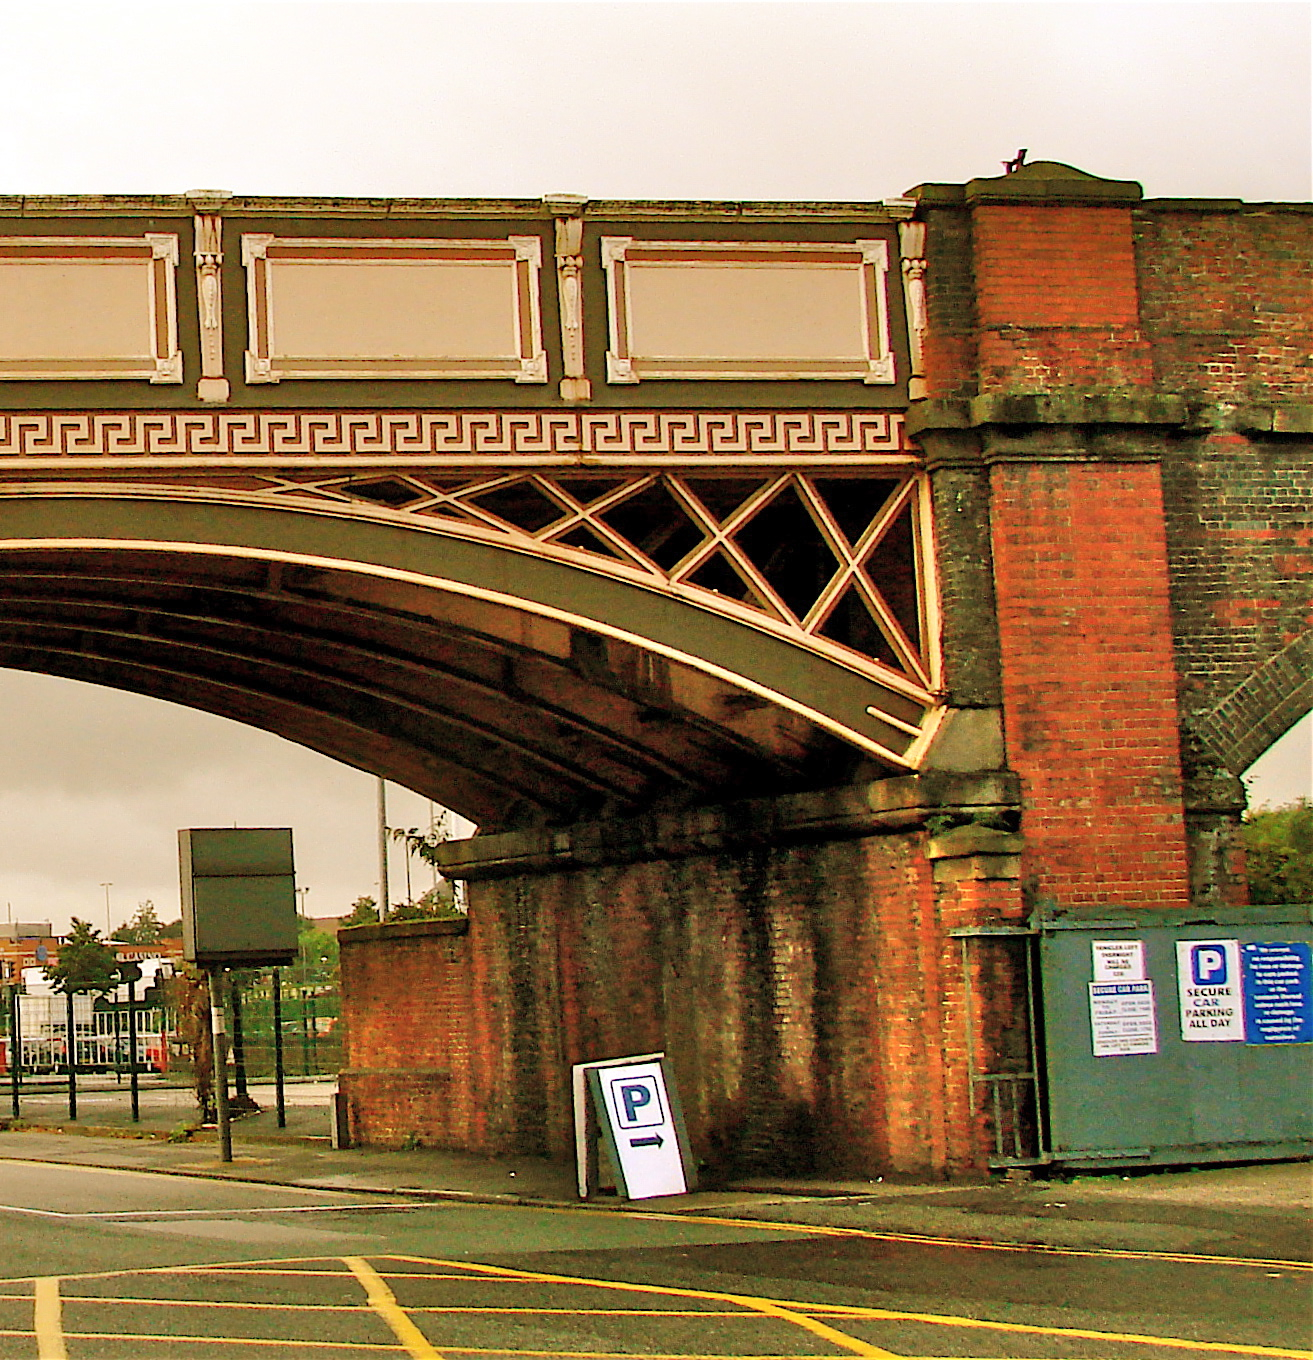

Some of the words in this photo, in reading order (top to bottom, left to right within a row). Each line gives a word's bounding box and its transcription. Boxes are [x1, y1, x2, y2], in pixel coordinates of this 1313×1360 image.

[1198, 950, 1222, 980] P
[1187, 987, 1232, 997] SECURE
[1193, 998, 1220, 1007] CAR
[1186, 1008, 1233, 1017] PARKING
[1189, 1019, 1208, 1028] ALL
[1210, 1019, 1231, 1028] DAY
[620, 1084, 651, 1122] P
